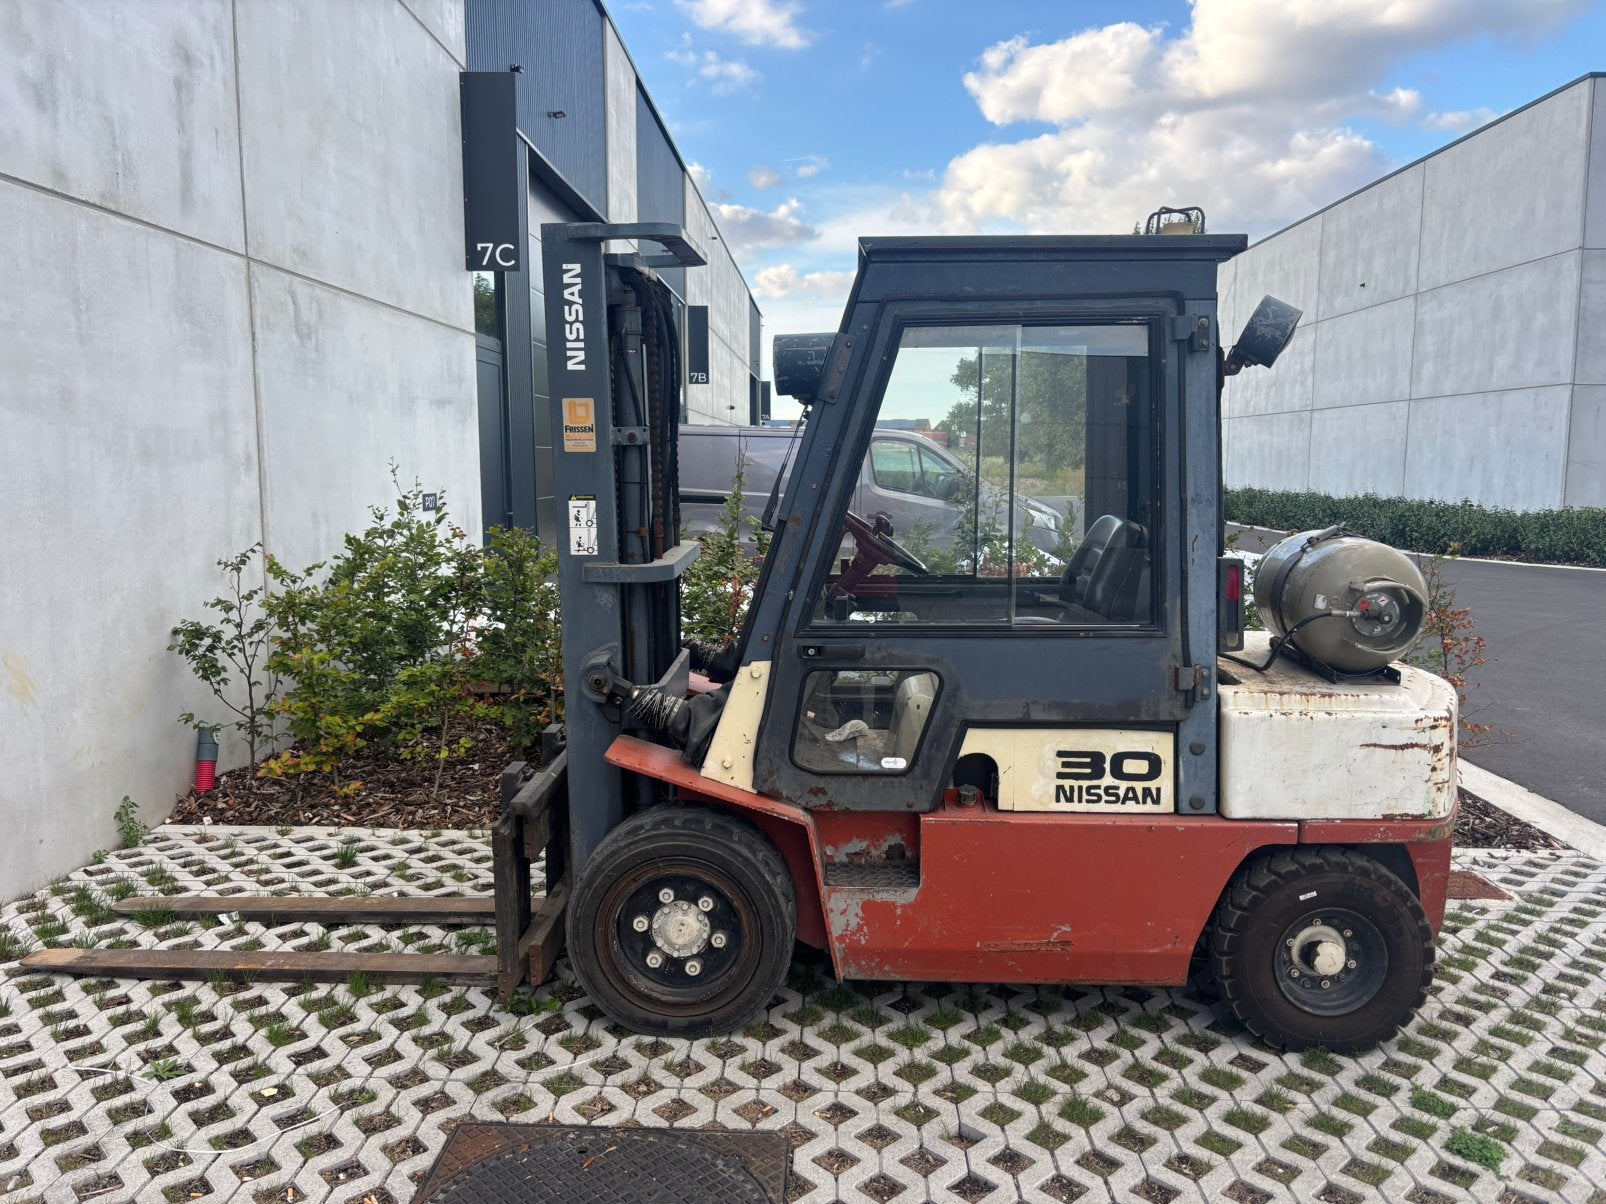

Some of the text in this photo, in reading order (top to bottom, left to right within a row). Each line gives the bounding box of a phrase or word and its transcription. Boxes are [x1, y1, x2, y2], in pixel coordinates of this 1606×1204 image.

[477, 243, 515, 266] 7C
[562, 263, 586, 371] NISSAN
[690, 372, 707, 383] 7B
[564, 424, 594, 433] FRISSEN
[1056, 750, 1162, 782] 30
[1055, 784, 1162, 805] NISSAN
